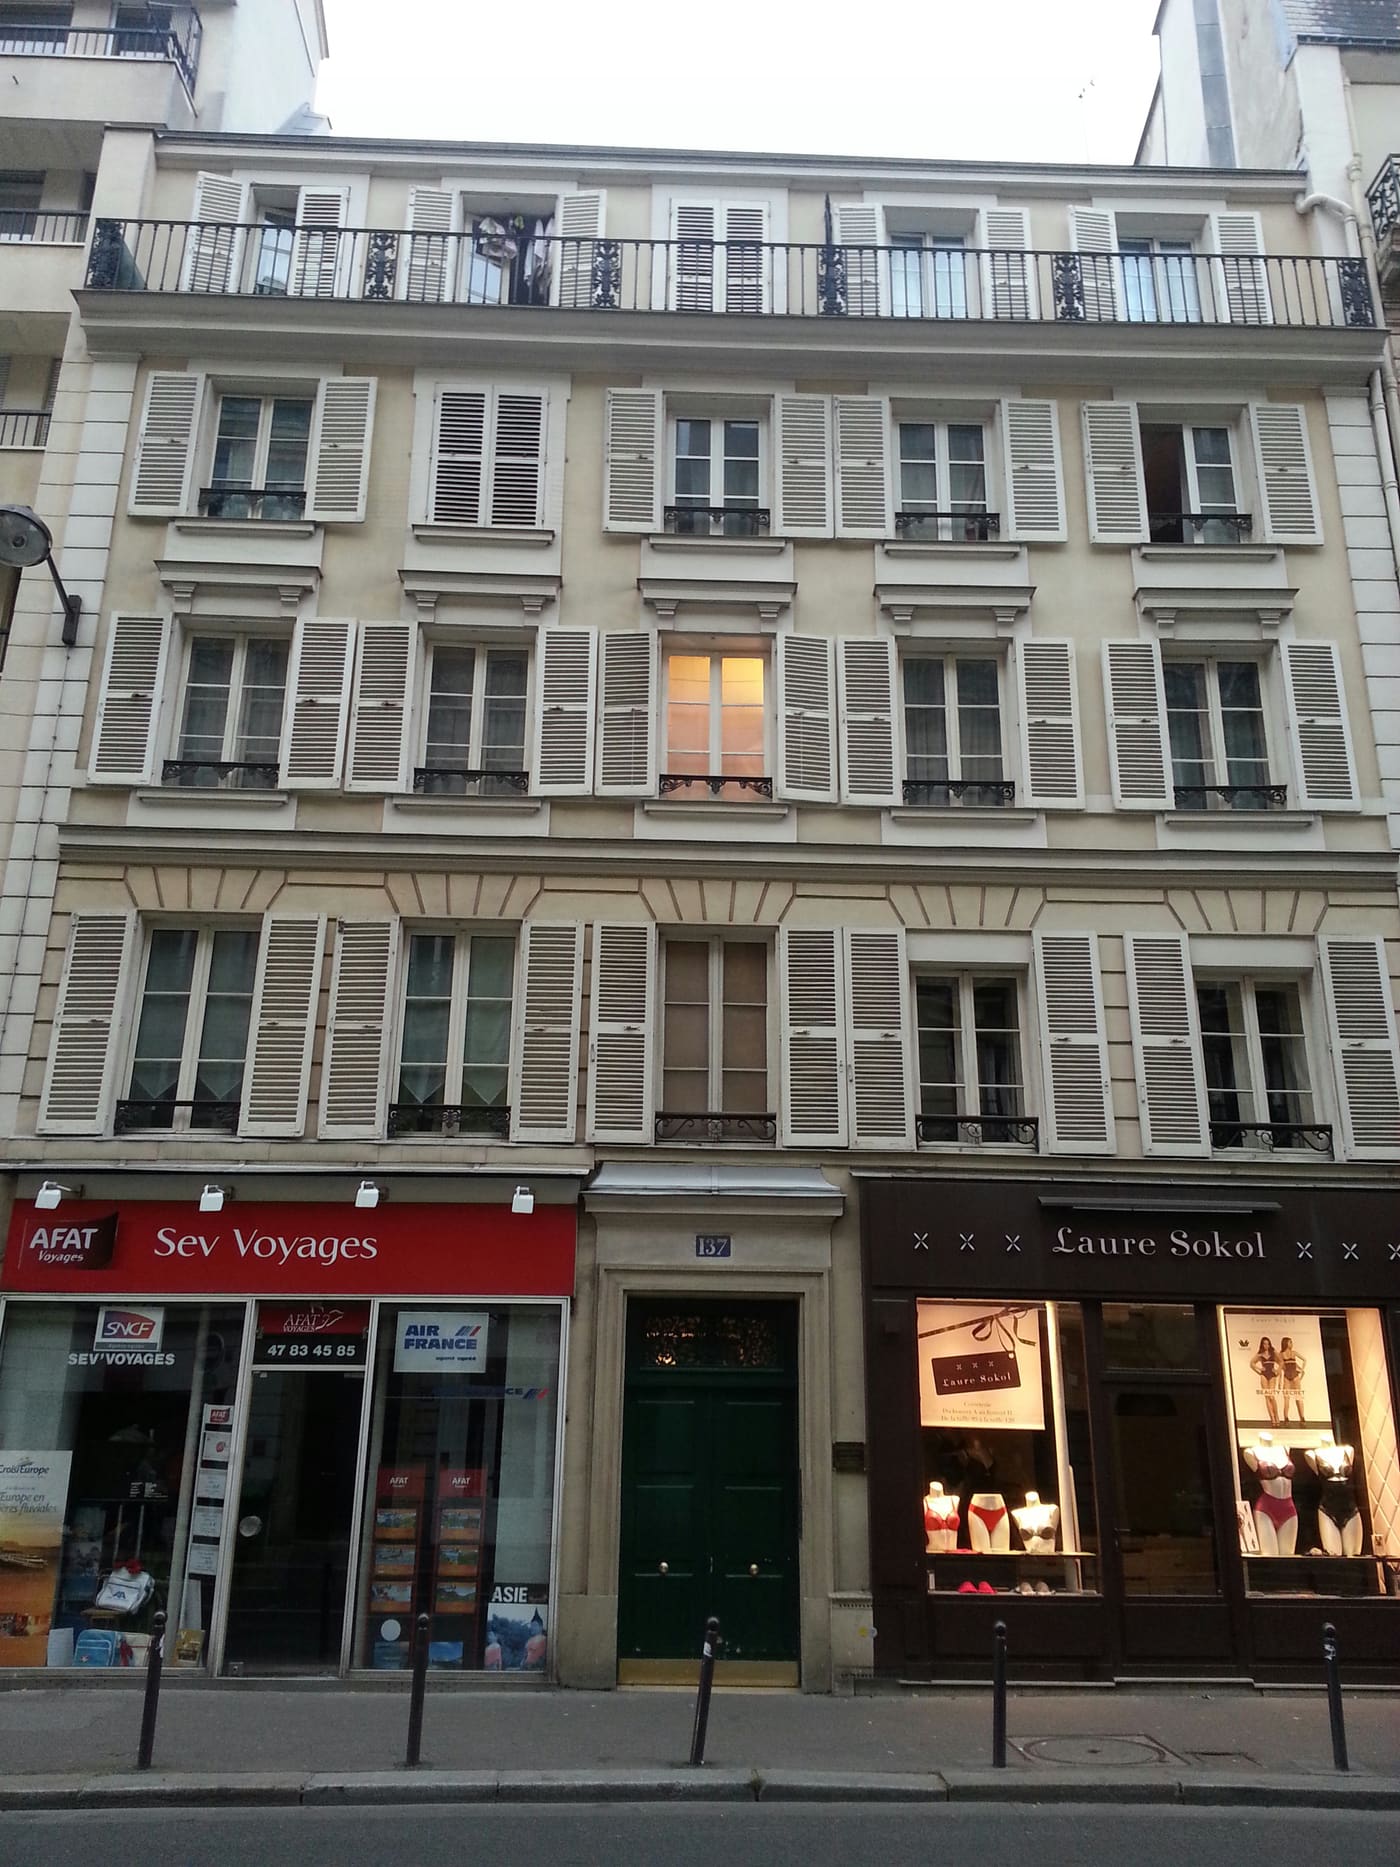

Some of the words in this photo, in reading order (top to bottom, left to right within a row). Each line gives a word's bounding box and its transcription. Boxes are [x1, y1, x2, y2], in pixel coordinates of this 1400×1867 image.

[30, 1228, 99, 1249] AFAT
[1052, 1226, 1156, 1255] Laure
[1170, 1229, 1267, 1258] Sokol
[154, 1227, 220, 1257] Sev
[233, 1228, 378, 1266] Voyages
[699, 1238, 728, 1255] 137
[37, 1250, 84, 1264] Voyages
[284, 1314, 321, 1326] AFAT
[104, 1321, 153, 1336] SNCF
[405, 1325, 440, 1336] AIR
[267, 1344, 287, 1357] 47
[289, 1344, 309, 1357] 83
[312, 1344, 332, 1357] 45
[336, 1344, 356, 1357] 85
[404, 1338, 478, 1350] FRANCE
[943, 1378, 976, 1387] Laure
[979, 1372, 1011, 1383] Sokol
[389, 1476, 409, 1485] AFAT
[452, 1476, 471, 1485] AFAT
[491, 1586, 529, 1603] ASIE
